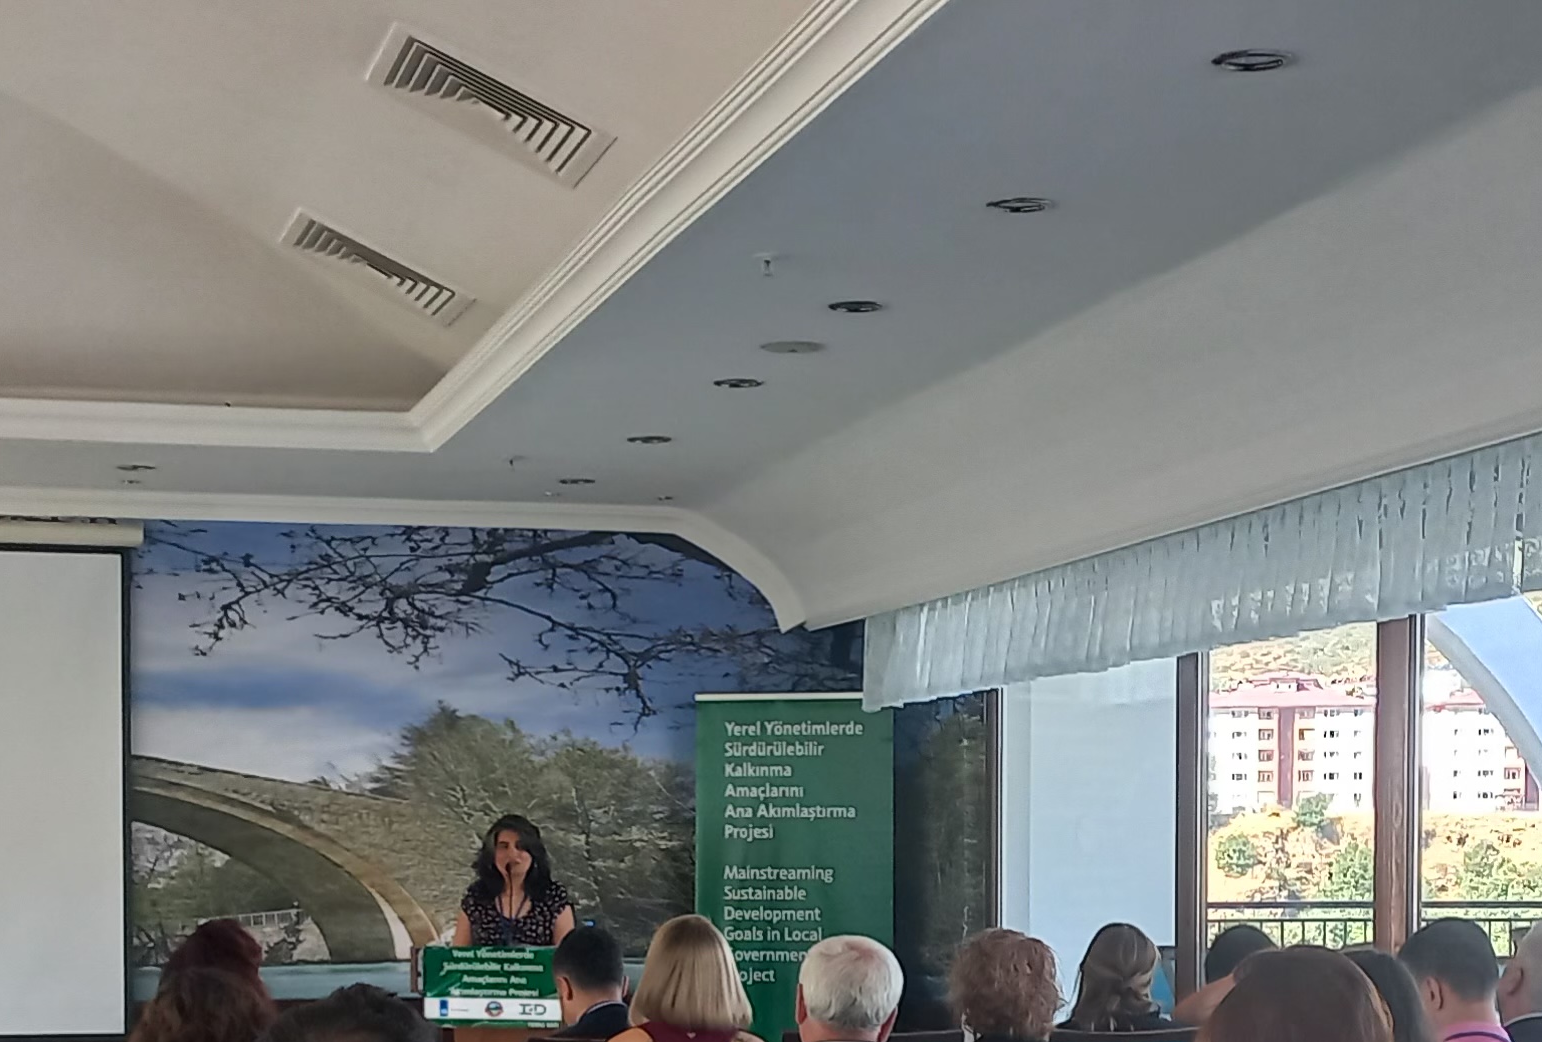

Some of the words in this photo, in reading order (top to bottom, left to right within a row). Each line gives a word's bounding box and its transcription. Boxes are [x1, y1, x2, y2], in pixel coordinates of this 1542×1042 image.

[724, 721, 761, 736] Yerel
[764, 721, 863, 736] Yönetimlerde
[724, 741, 825, 757] Sürdürülebilir
[724, 763, 792, 777] Kalkınma
[724, 783, 804, 800] Amaçlarını
[724, 804, 753, 818] Ana
[756, 804, 856, 821] Akımlaştırma
[724, 824, 774, 842] Projesi
[723, 865, 834, 883] Mainstreaming
[723, 886, 806, 901] Sustainable
[723, 906, 821, 924] Development
[723, 926, 764, 941] Goals
[767, 926, 781, 941] in
[784, 926, 823, 941] Local
[731, 947, 809, 962] overnmen
[739, 967, 776, 985] oject
